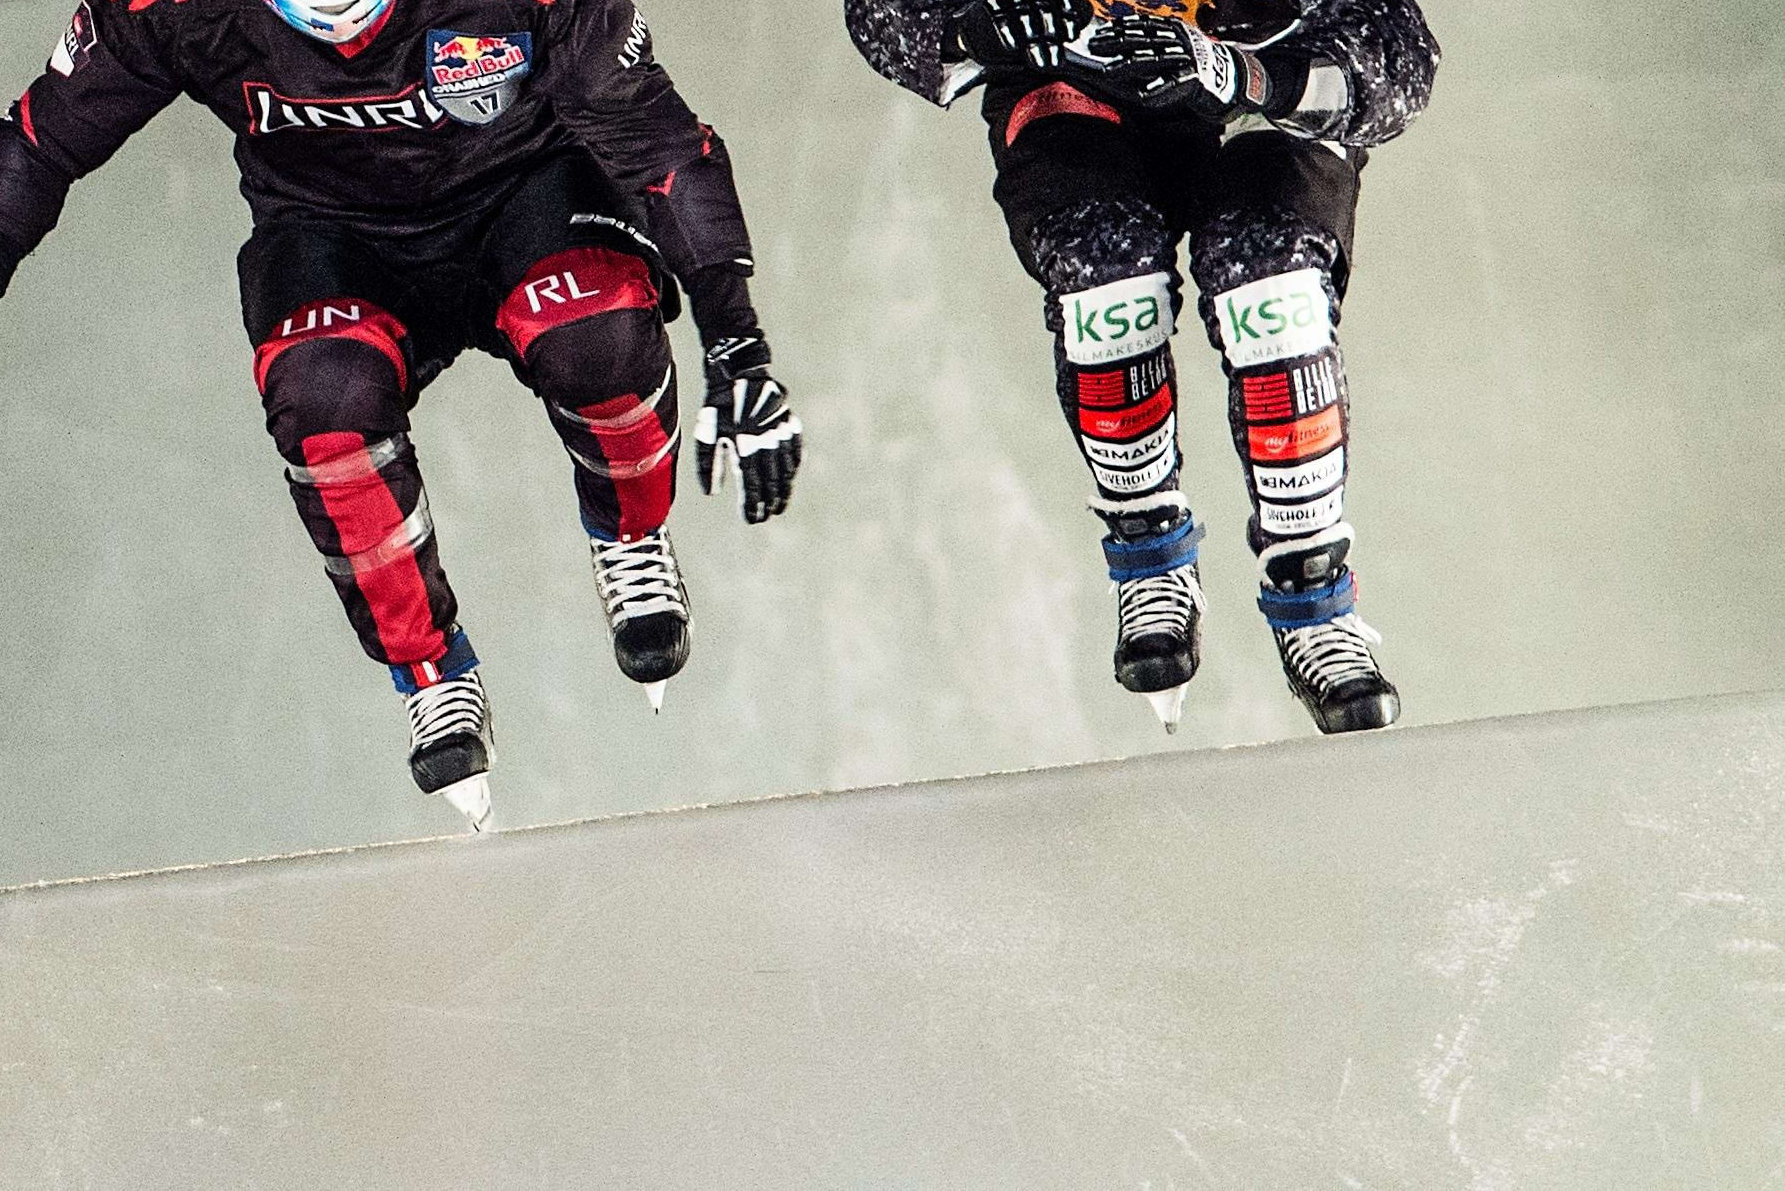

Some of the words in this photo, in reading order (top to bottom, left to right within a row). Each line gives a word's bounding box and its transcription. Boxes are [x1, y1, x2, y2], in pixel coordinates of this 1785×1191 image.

[434, 59, 480, 85] Red
[478, 47, 523, 73] Bull
[524, 272, 600, 314] RL
[282, 305, 360, 337] UN
[1075, 296, 1159, 343] ksa
[1227, 292, 1315, 343] ksa
